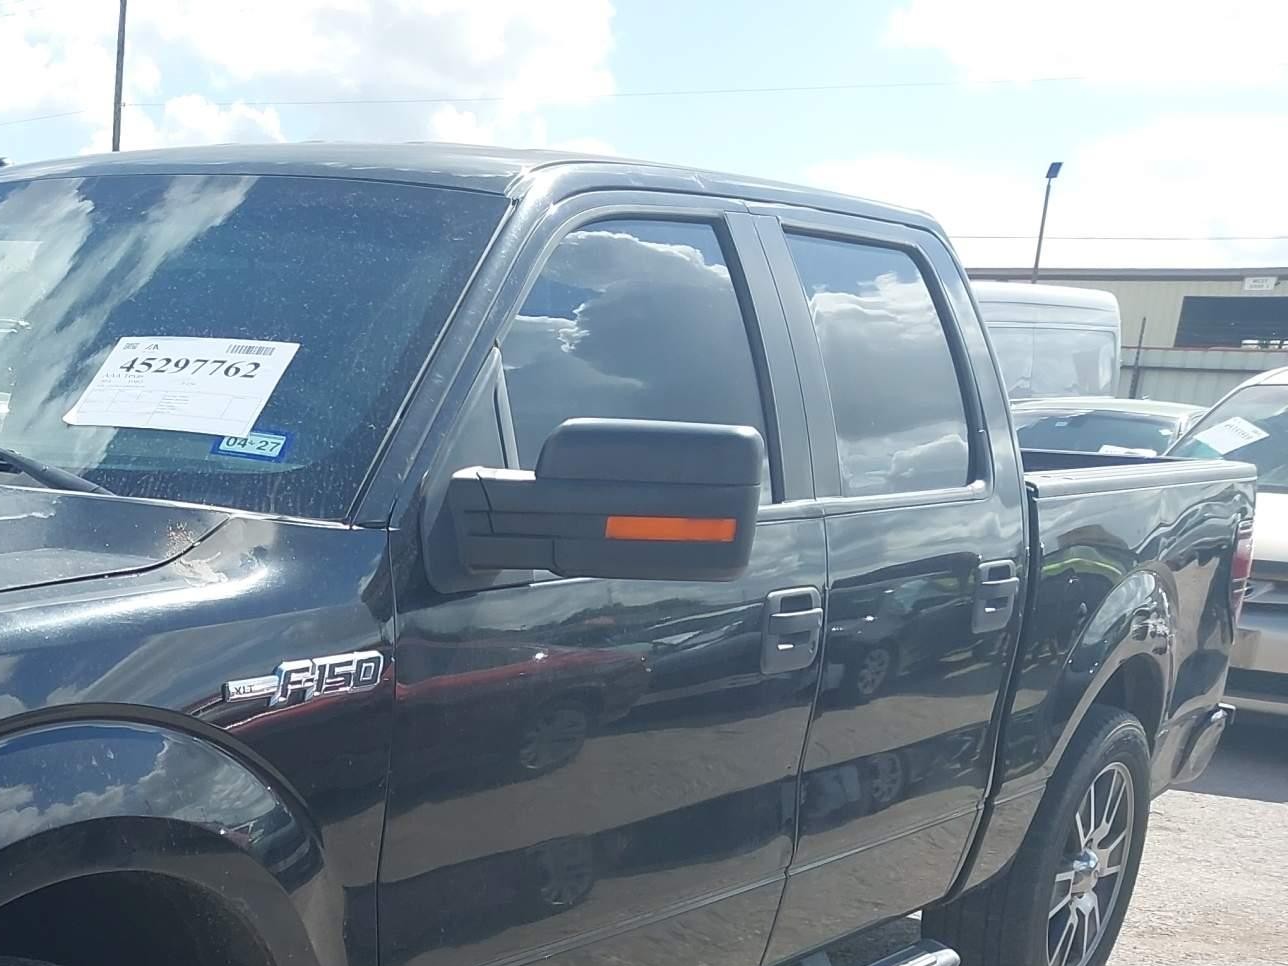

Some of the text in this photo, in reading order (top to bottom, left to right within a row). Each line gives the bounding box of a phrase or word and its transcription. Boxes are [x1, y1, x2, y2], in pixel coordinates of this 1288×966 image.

[119, 356, 261, 379] 45297762
[225, 436, 281, 452] 04 27
[268, 650, 384, 707] F-150
[233, 684, 255, 696] XLT
